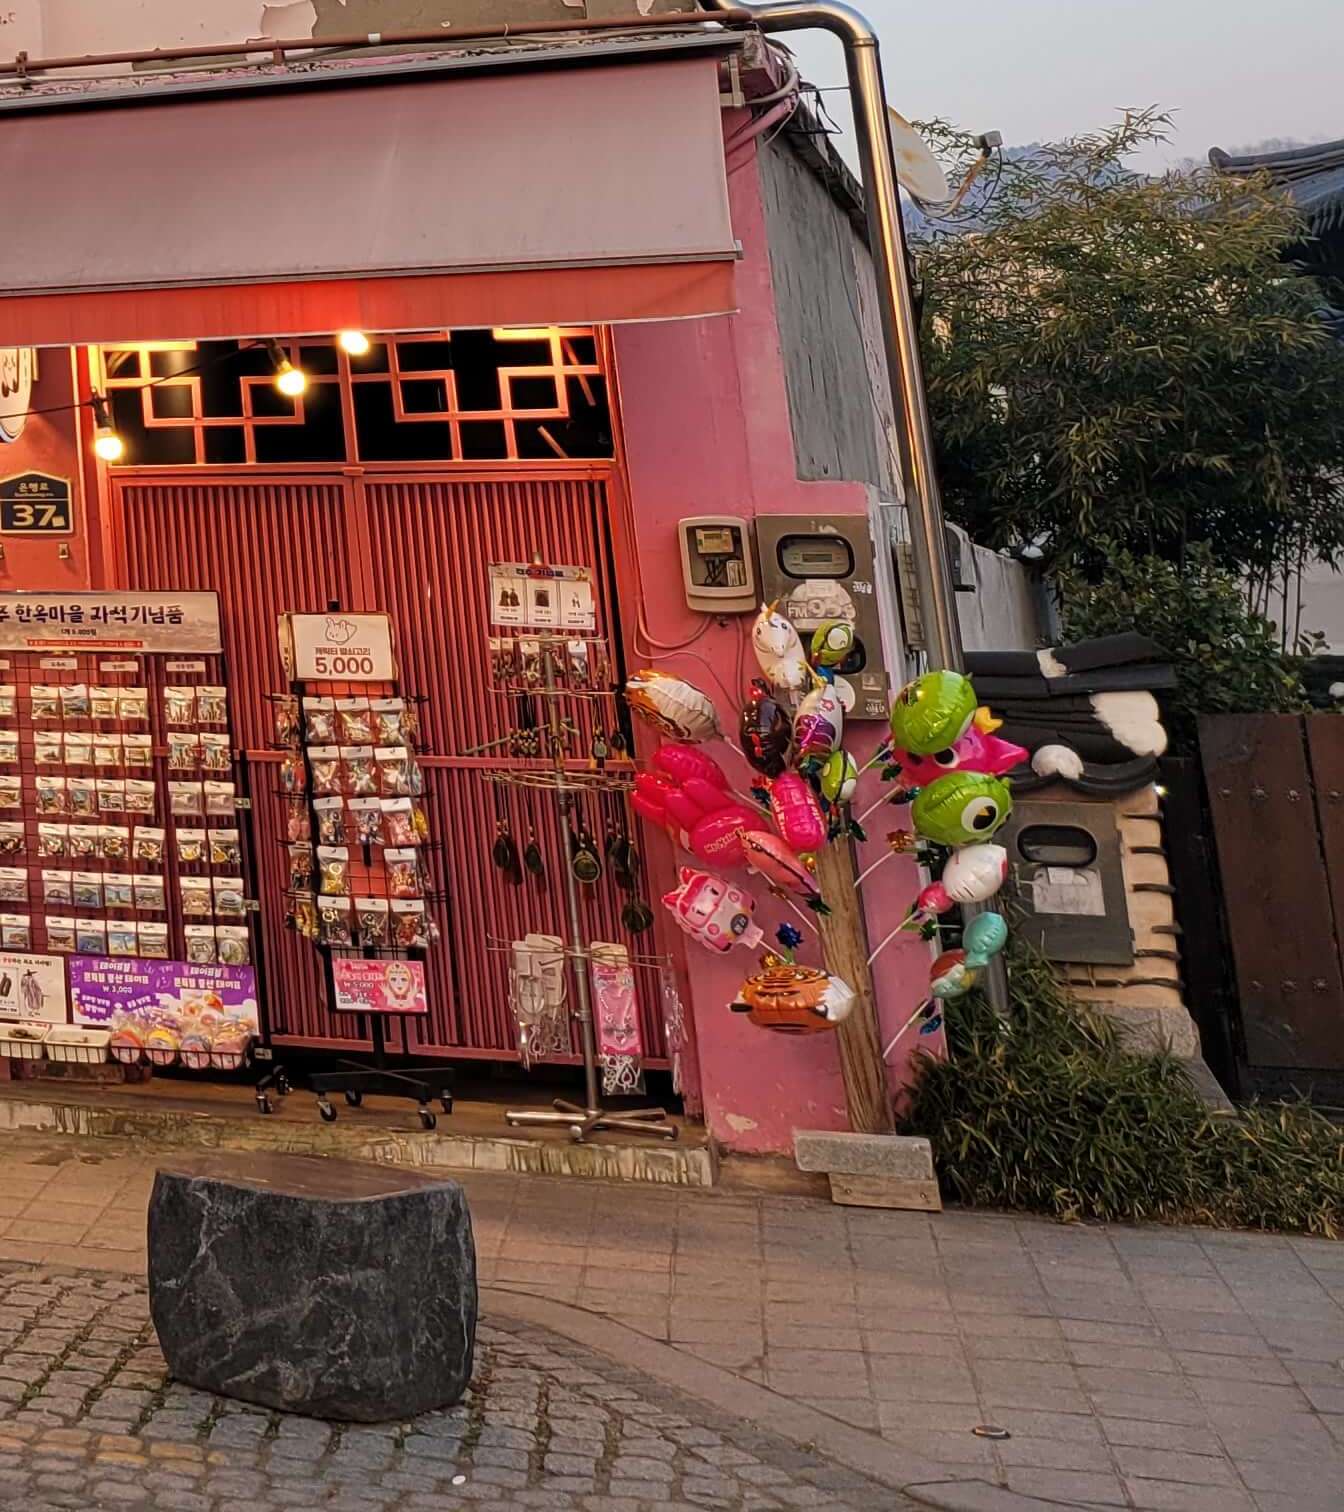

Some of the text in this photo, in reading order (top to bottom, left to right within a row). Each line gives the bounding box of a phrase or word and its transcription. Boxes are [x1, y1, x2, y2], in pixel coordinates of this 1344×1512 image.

[13, 504, 57, 526] 37
[15, 604, 85, 623] 한옥마을
[788, 606, 807, 619] FM
[315, 657, 374, 676] 5,000
